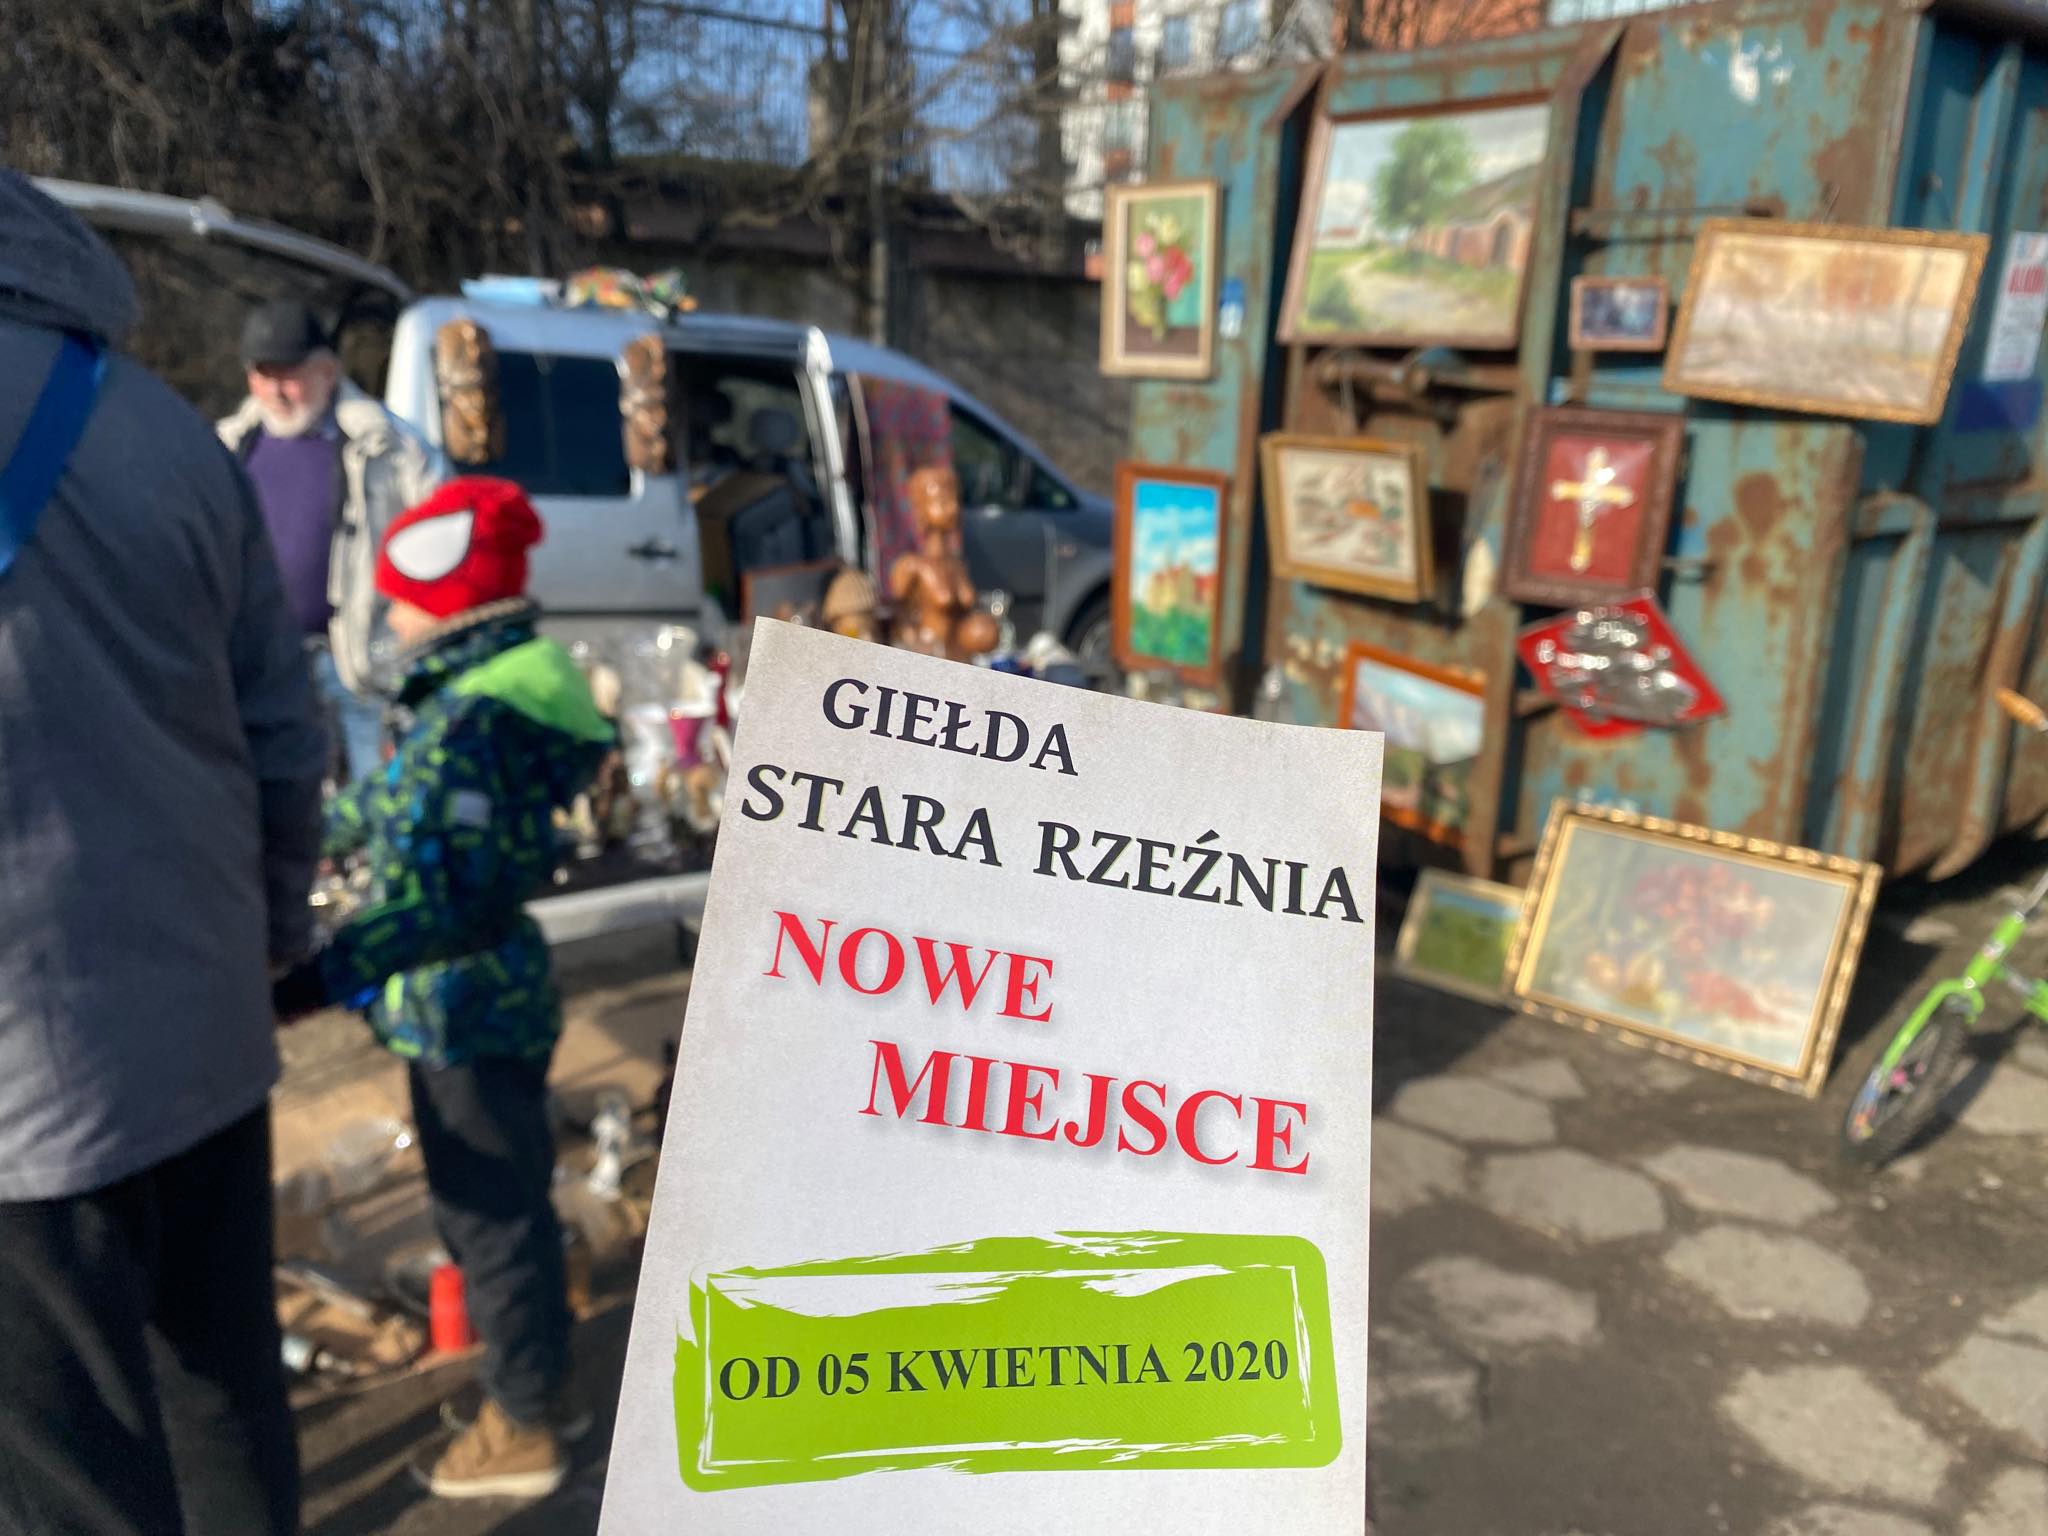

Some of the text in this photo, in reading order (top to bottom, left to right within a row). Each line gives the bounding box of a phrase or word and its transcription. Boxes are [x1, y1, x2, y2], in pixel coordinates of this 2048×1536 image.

[823, 678, 1078, 776] GIEŁDA
[741, 764, 1364, 923] STARA RZEŹNIA
[763, 911, 1054, 1022] NOWE
[858, 1040, 1310, 1175] MIEJSCE
[719, 1339, 1288, 1401] OD 05 KWIETNIA 2020
